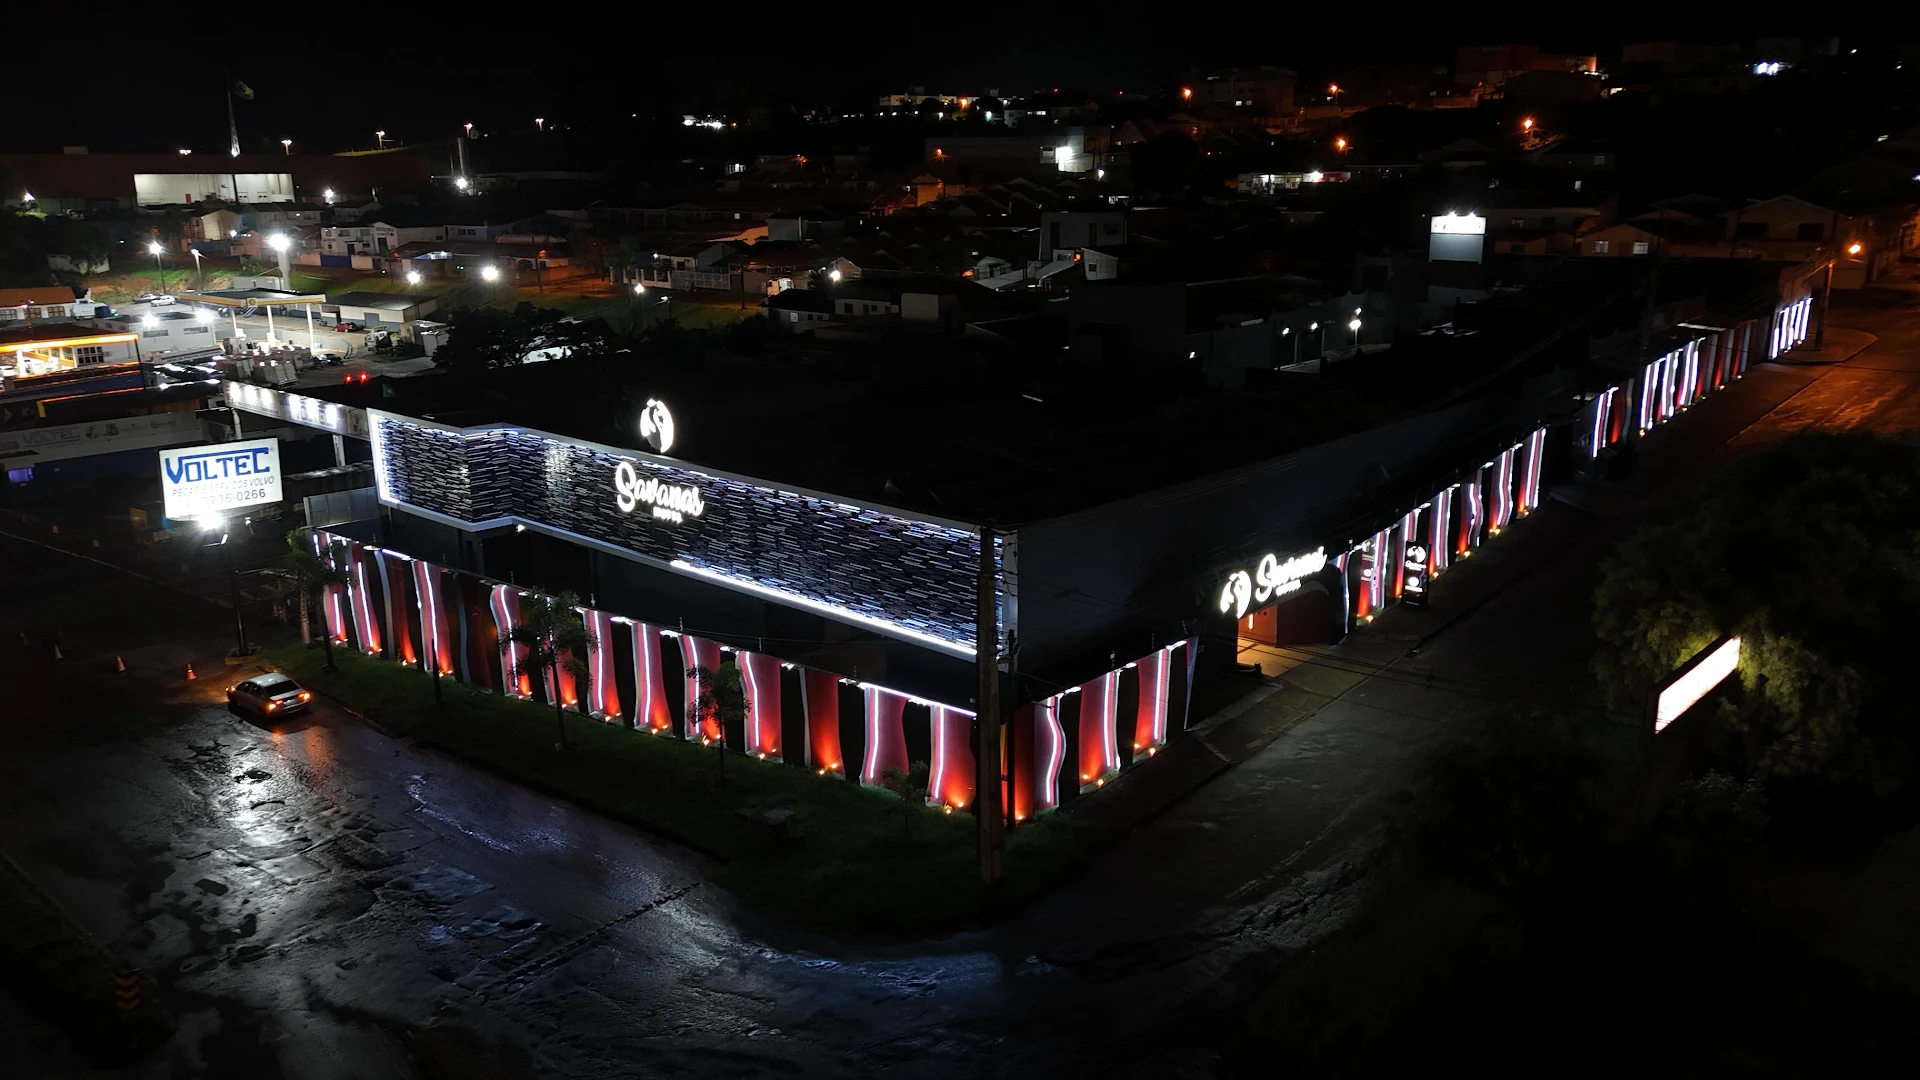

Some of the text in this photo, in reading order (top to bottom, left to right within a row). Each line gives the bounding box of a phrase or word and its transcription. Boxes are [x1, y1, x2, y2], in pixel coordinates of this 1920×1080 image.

[165, 447, 271, 485] VOLTEC
[249, 475, 275, 487] VOLVO
[615, 461, 705, 516] Savanas
